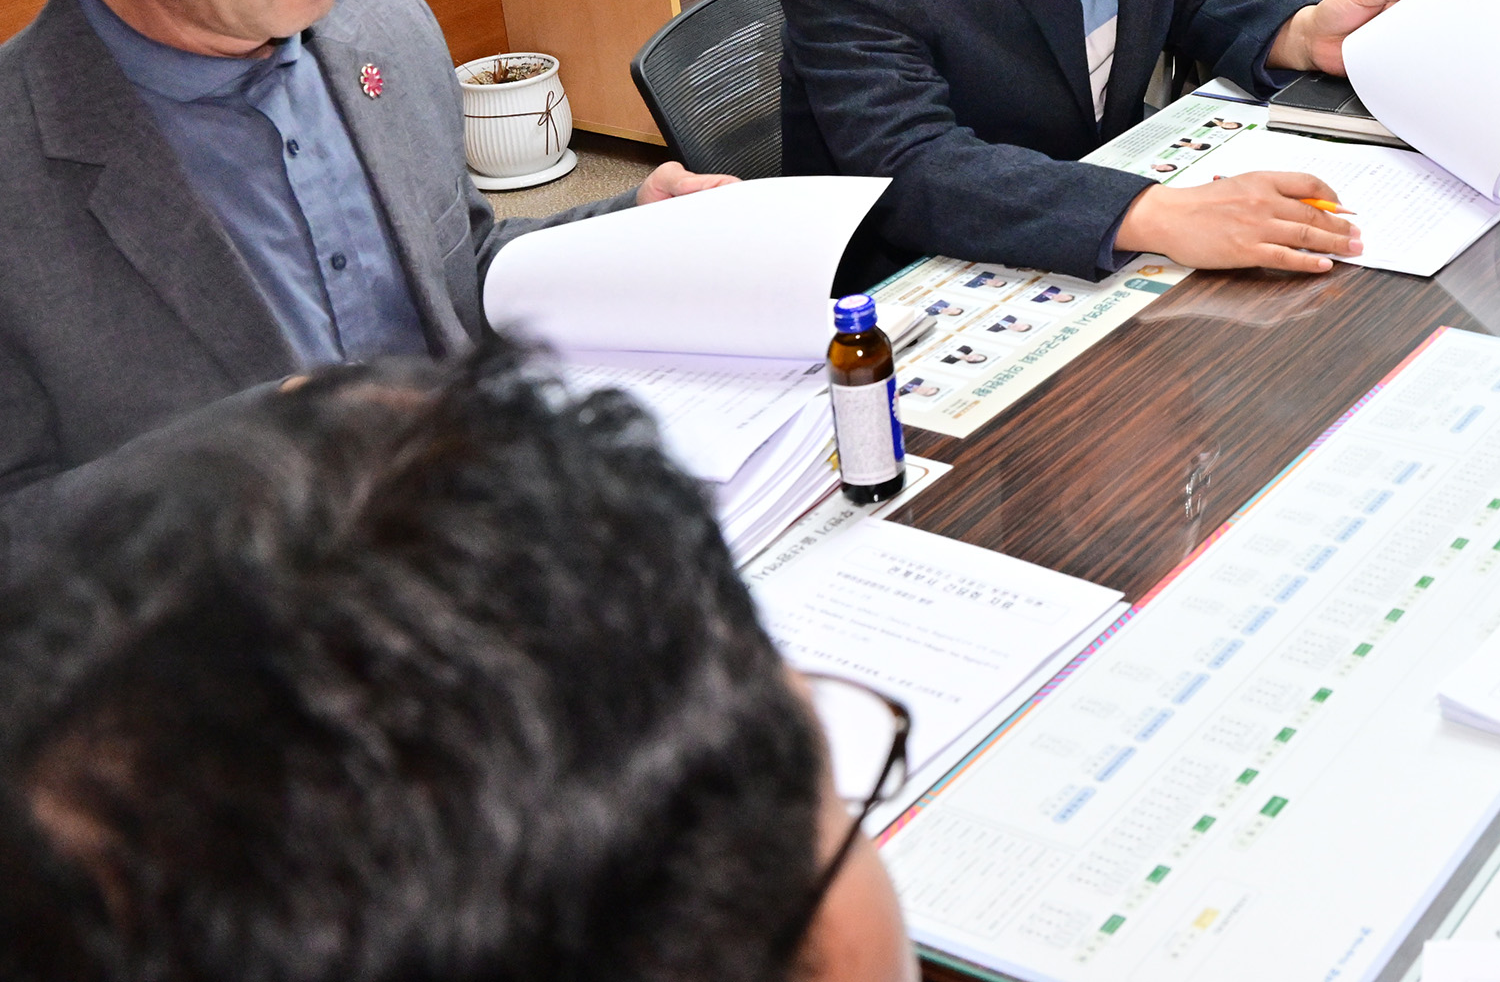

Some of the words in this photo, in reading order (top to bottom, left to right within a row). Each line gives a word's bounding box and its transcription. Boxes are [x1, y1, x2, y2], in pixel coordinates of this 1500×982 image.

[1076, 290, 1131, 328] 울산광역시
[1023, 324, 1080, 364] 울주군의회
[971, 363, 1025, 399] 의원현황
